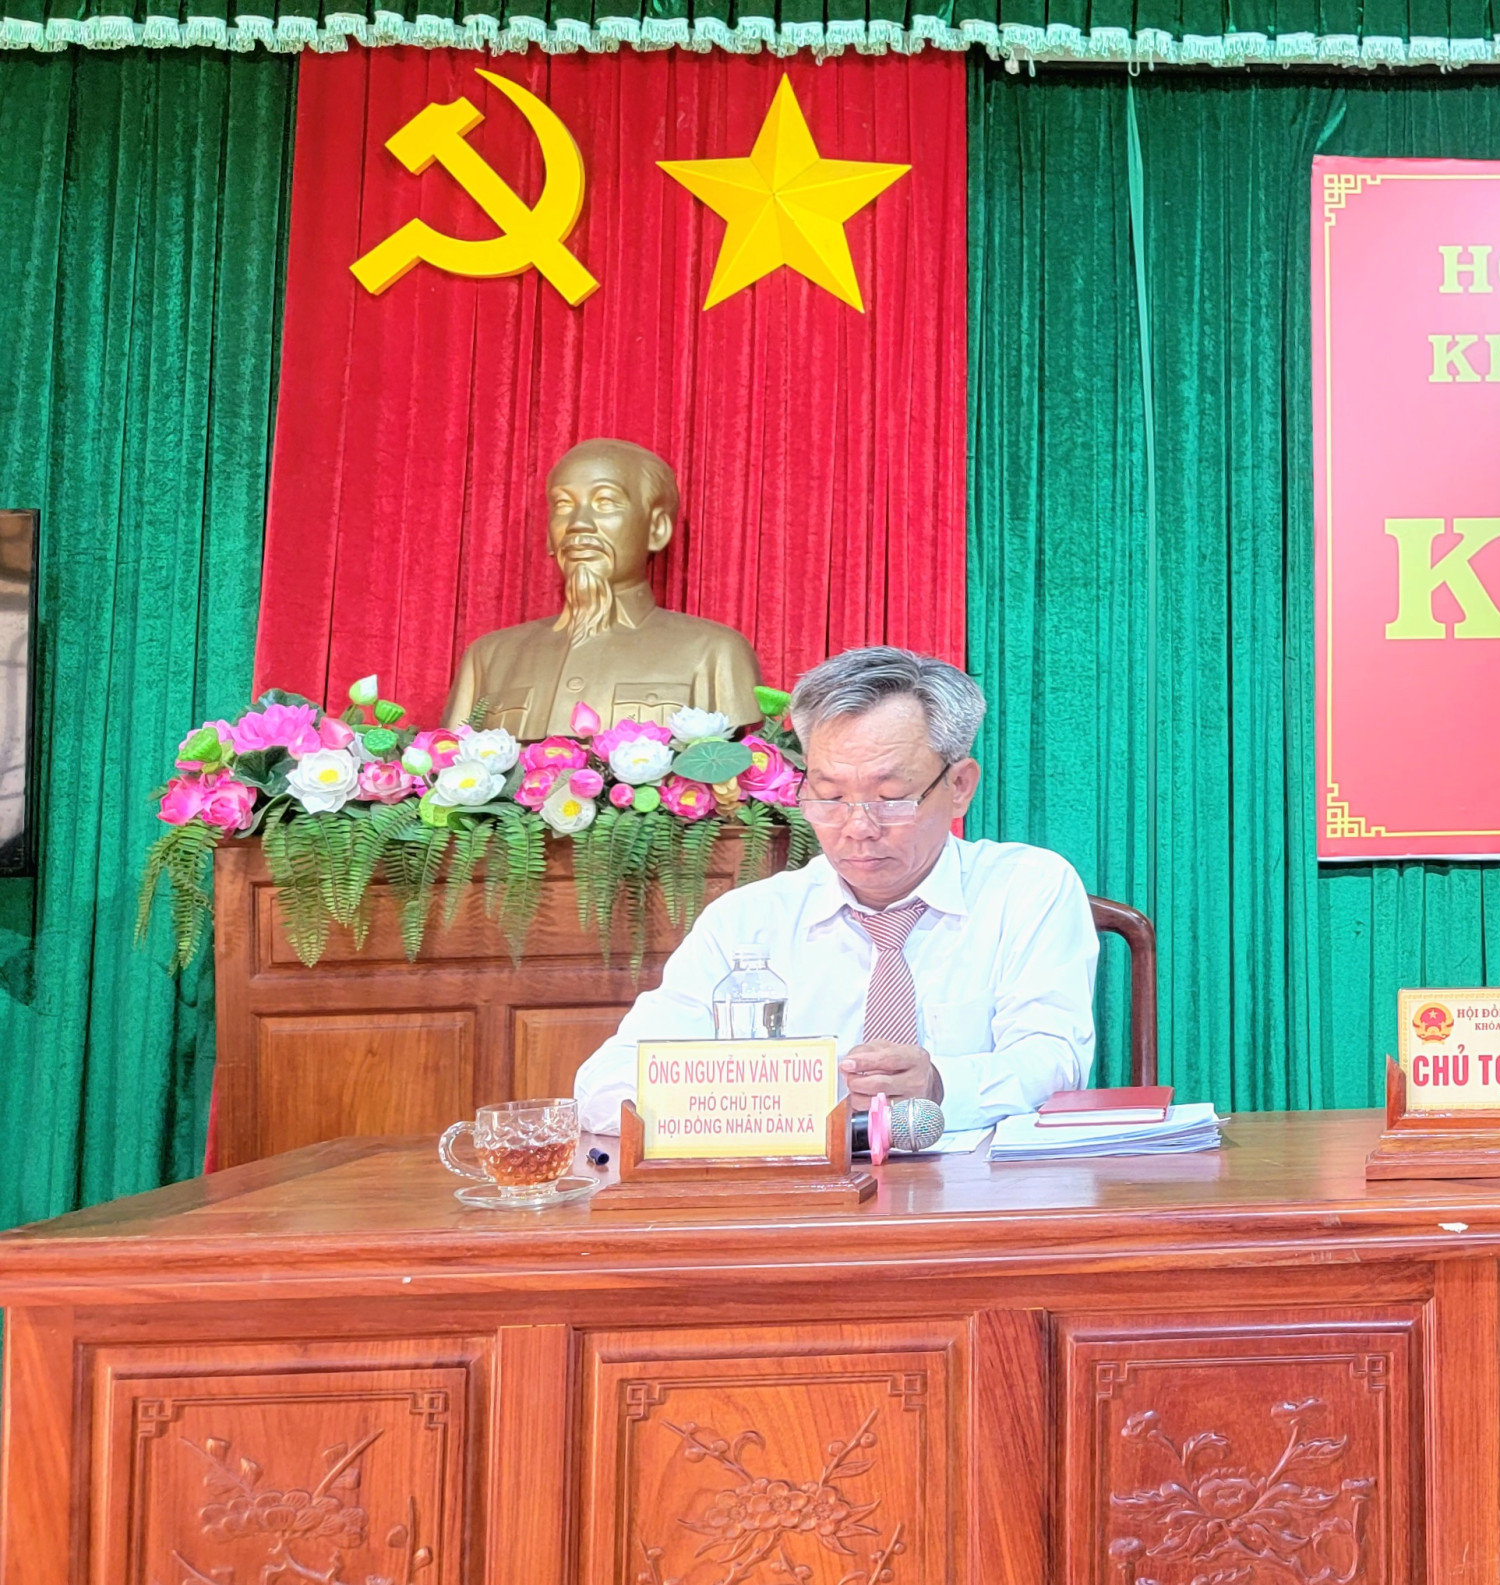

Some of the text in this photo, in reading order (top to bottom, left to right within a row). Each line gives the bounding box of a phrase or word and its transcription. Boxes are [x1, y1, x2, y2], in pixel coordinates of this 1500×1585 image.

[1457, 1006, 1479, 1021] HỘI
[648, 1052, 823, 1084] ÔNG NGUYỄN VĂN TÙNG
[1412, 1044, 1469, 1087] CHỦ
[689, 1092, 781, 1115] PHÓ CHỦ TỊCH
[726, 1114, 762, 1134] NHÂN
[766, 1114, 793, 1133] DÂN
[797, 1114, 814, 1133] XÃ
